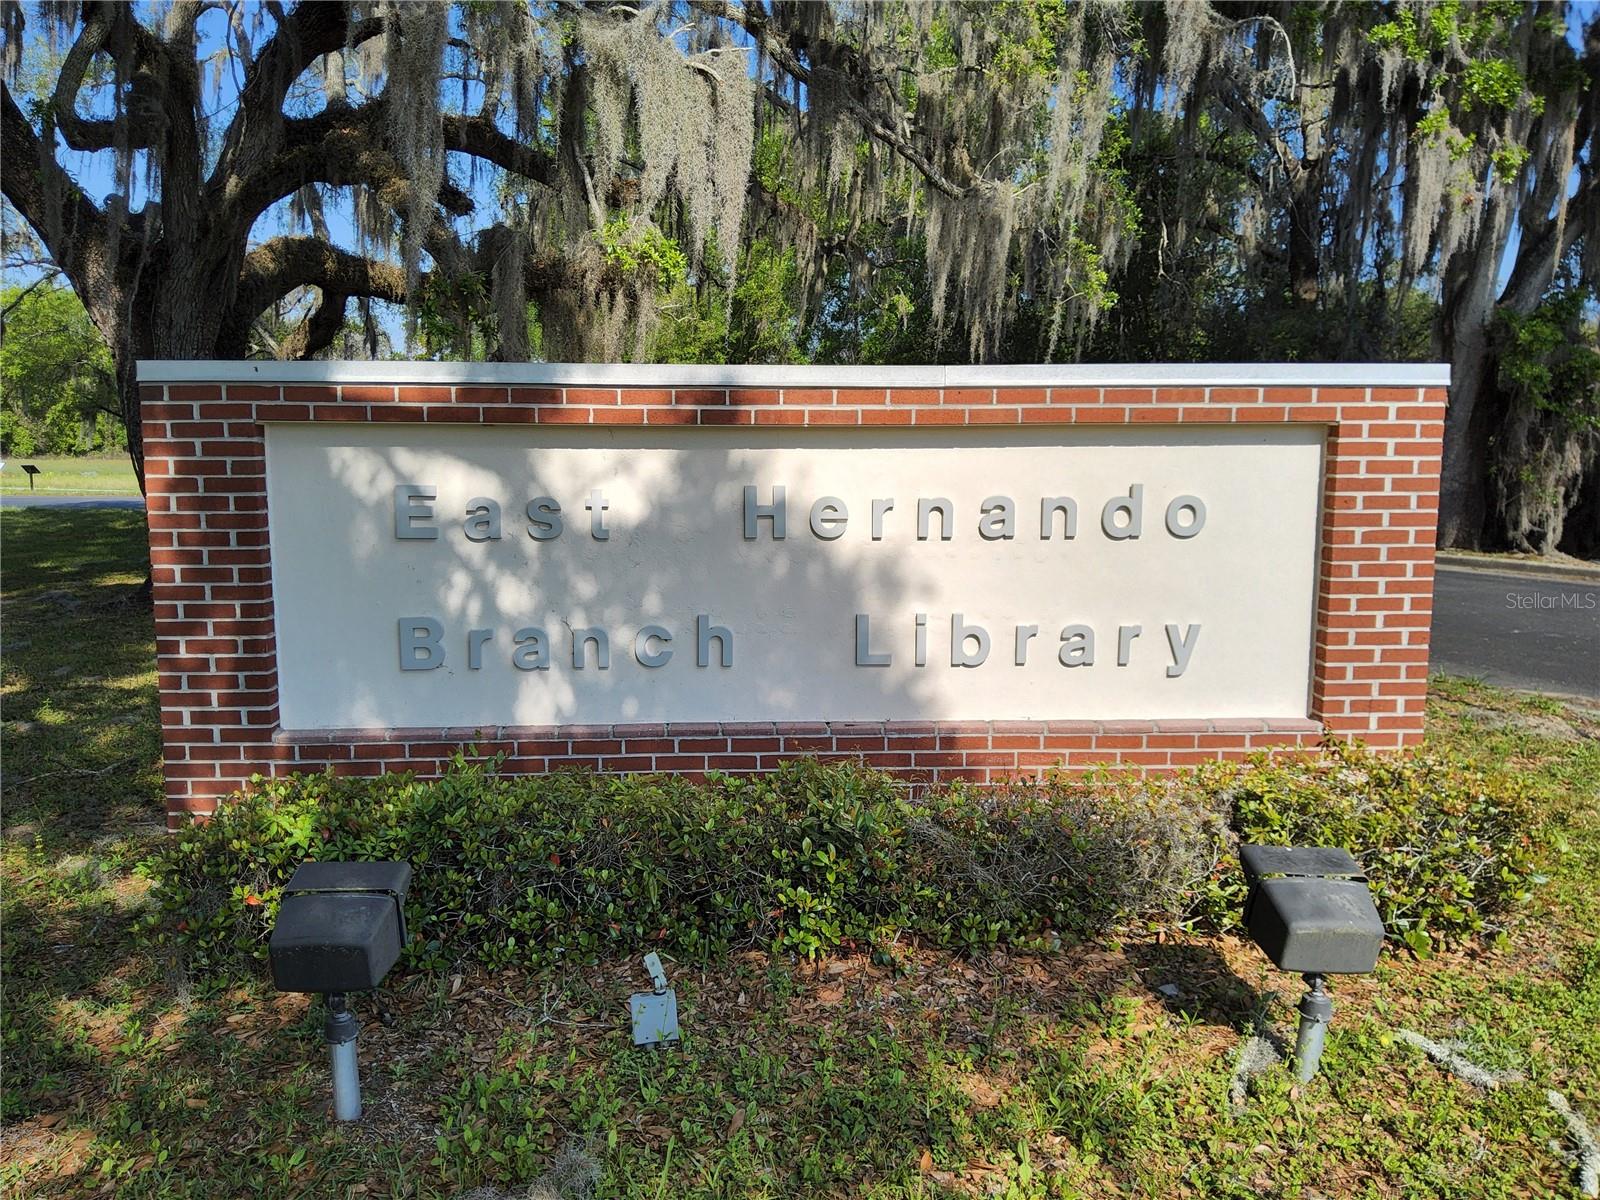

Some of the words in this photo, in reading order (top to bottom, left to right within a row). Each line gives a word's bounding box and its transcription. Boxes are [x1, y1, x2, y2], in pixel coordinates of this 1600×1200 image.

[395, 485, 610, 541] East
[743, 484, 1207, 541] Hernando
[399, 614, 734, 671] Branch
[855, 613, 1202, 678] Library
